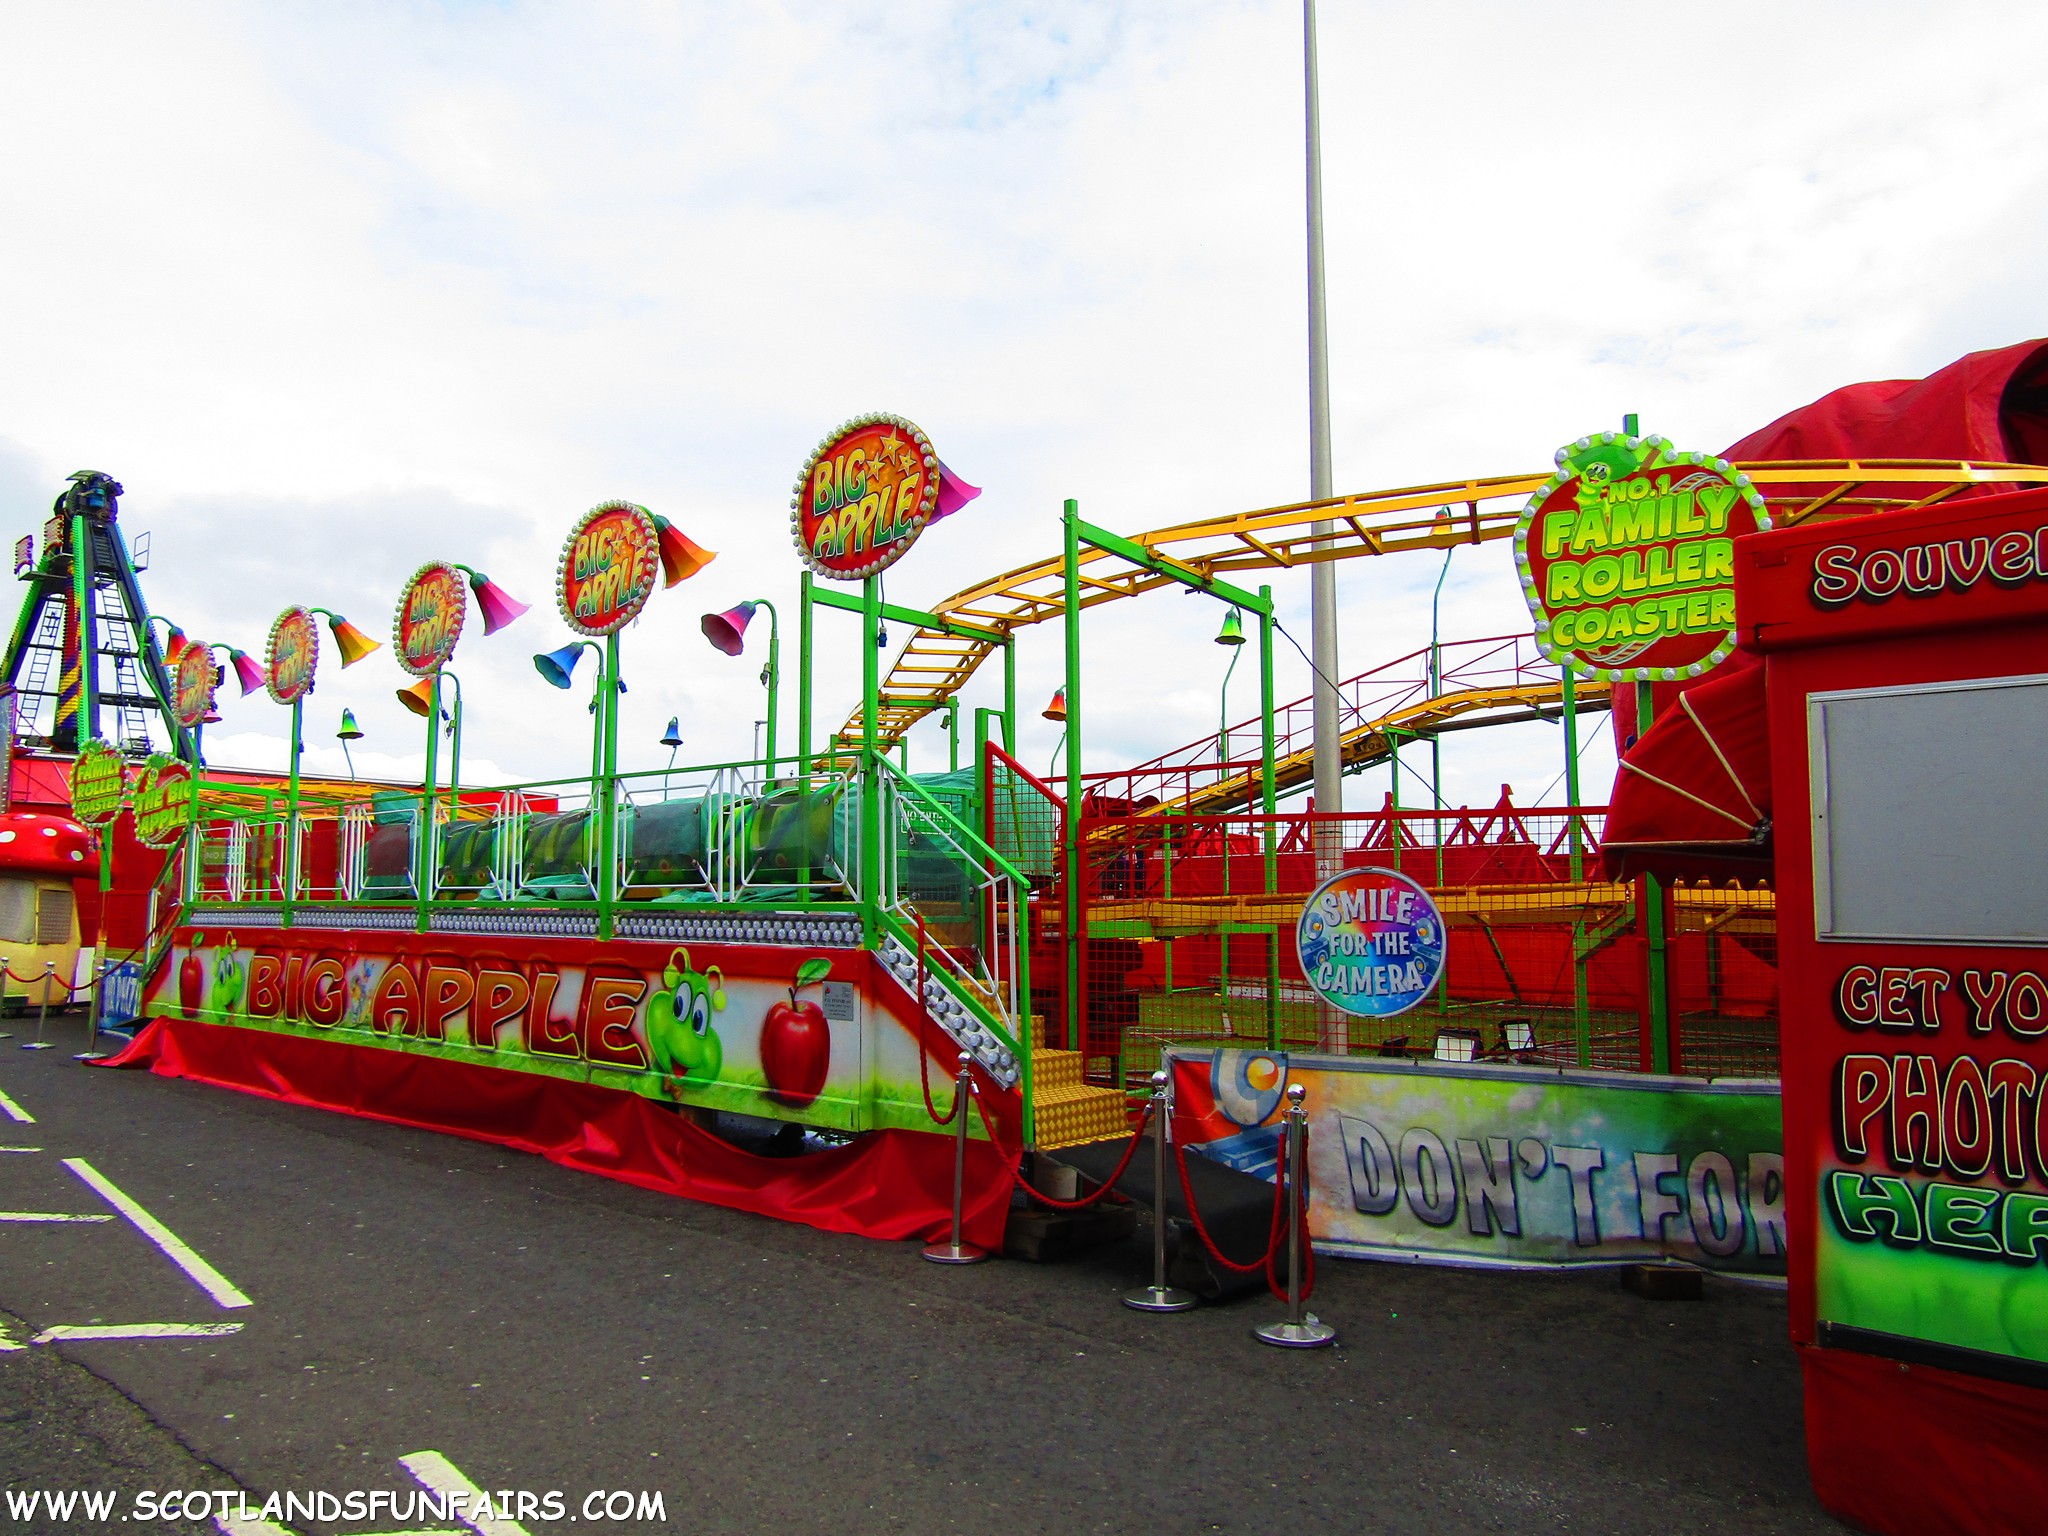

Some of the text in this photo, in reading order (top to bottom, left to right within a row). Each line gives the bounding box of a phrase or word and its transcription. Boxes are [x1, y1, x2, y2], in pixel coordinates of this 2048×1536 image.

[814, 448, 866, 516] BIG
[1609, 474, 1671, 503] NO.1
[813, 472, 920, 559] APPLE
[1543, 486, 1740, 557] FAMILY
[575, 528, 613, 580] BIG
[1547, 538, 1734, 607] ROLLER
[1813, 526, 2048, 602] Souve
[410, 581, 439, 623] BIG
[575, 545, 648, 618] APPLE
[406, 604, 457, 658] APPLE
[1551, 590, 1736, 650] COASTER
[77, 759, 121, 782] FAMILY
[77, 776, 122, 798] ROLLER
[75, 796, 121, 814] COASTER
[135, 789, 163, 813] THE
[139, 804, 188, 834] APPLE
[1320, 888, 1415, 927] SMILE
[1329, 931, 1410, 956] FOR THE
[1317, 962, 1425, 996] CAMERA
[1840, 965, 1950, 1028] GET
[247, 955, 347, 1028] BIG
[371, 962, 648, 1070] APPLE
[1842, 1055, 2048, 1179] PHOT
[1340, 1116, 1786, 1256] DON'T FOR
